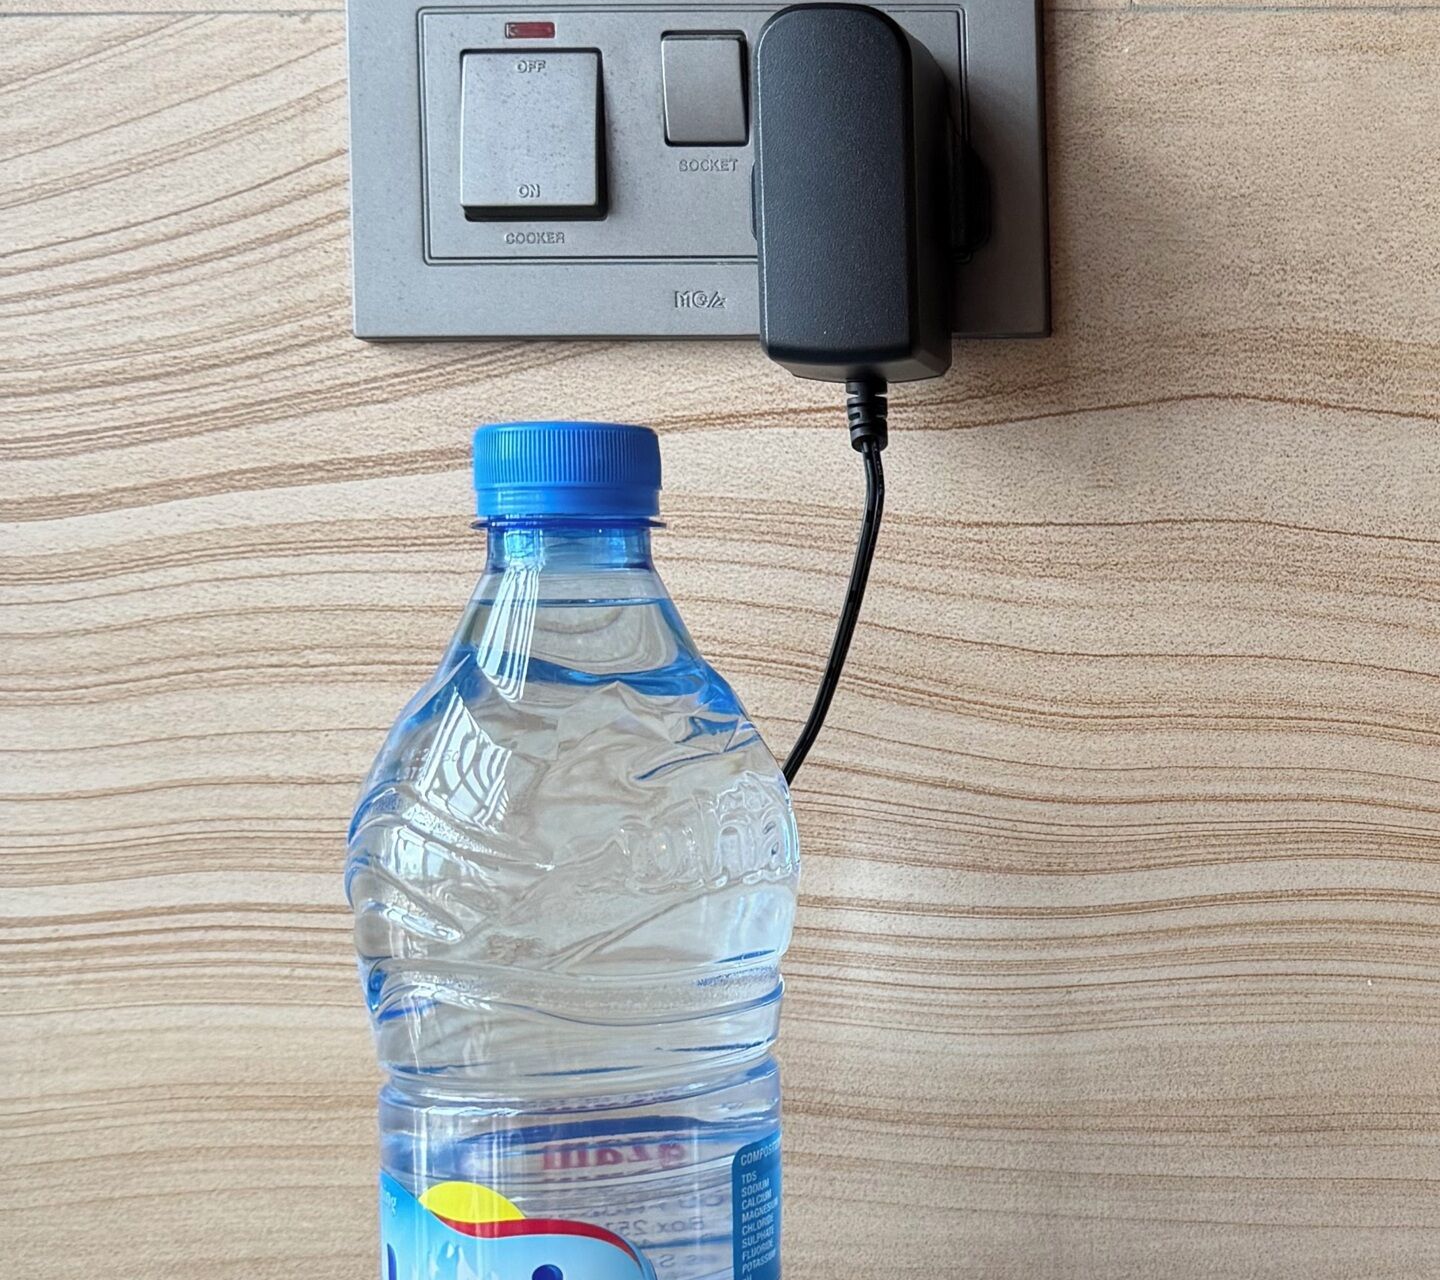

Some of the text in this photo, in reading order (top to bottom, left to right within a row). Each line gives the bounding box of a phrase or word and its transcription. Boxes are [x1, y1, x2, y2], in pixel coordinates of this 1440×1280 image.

[517, 60, 546, 73] OFF
[679, 159, 739, 172] SOCKET
[518, 184, 540, 198] ON
[504, 232, 565, 245] COOKER
[742, 1171, 757, 1184] TDS
[742, 1177, 770, 1198] SODIUM
[742, 1188, 772, 1210] CALCIUM
[742, 1197, 778, 1223] MAGNESIUM
[742, 1213, 774, 1236] CHLORIDE
[742, 1225, 774, 1248] SULPHATE
[742, 1238, 773, 1261] FLUORIDE
[742, 1248, 776, 1274] POTASSIUM
